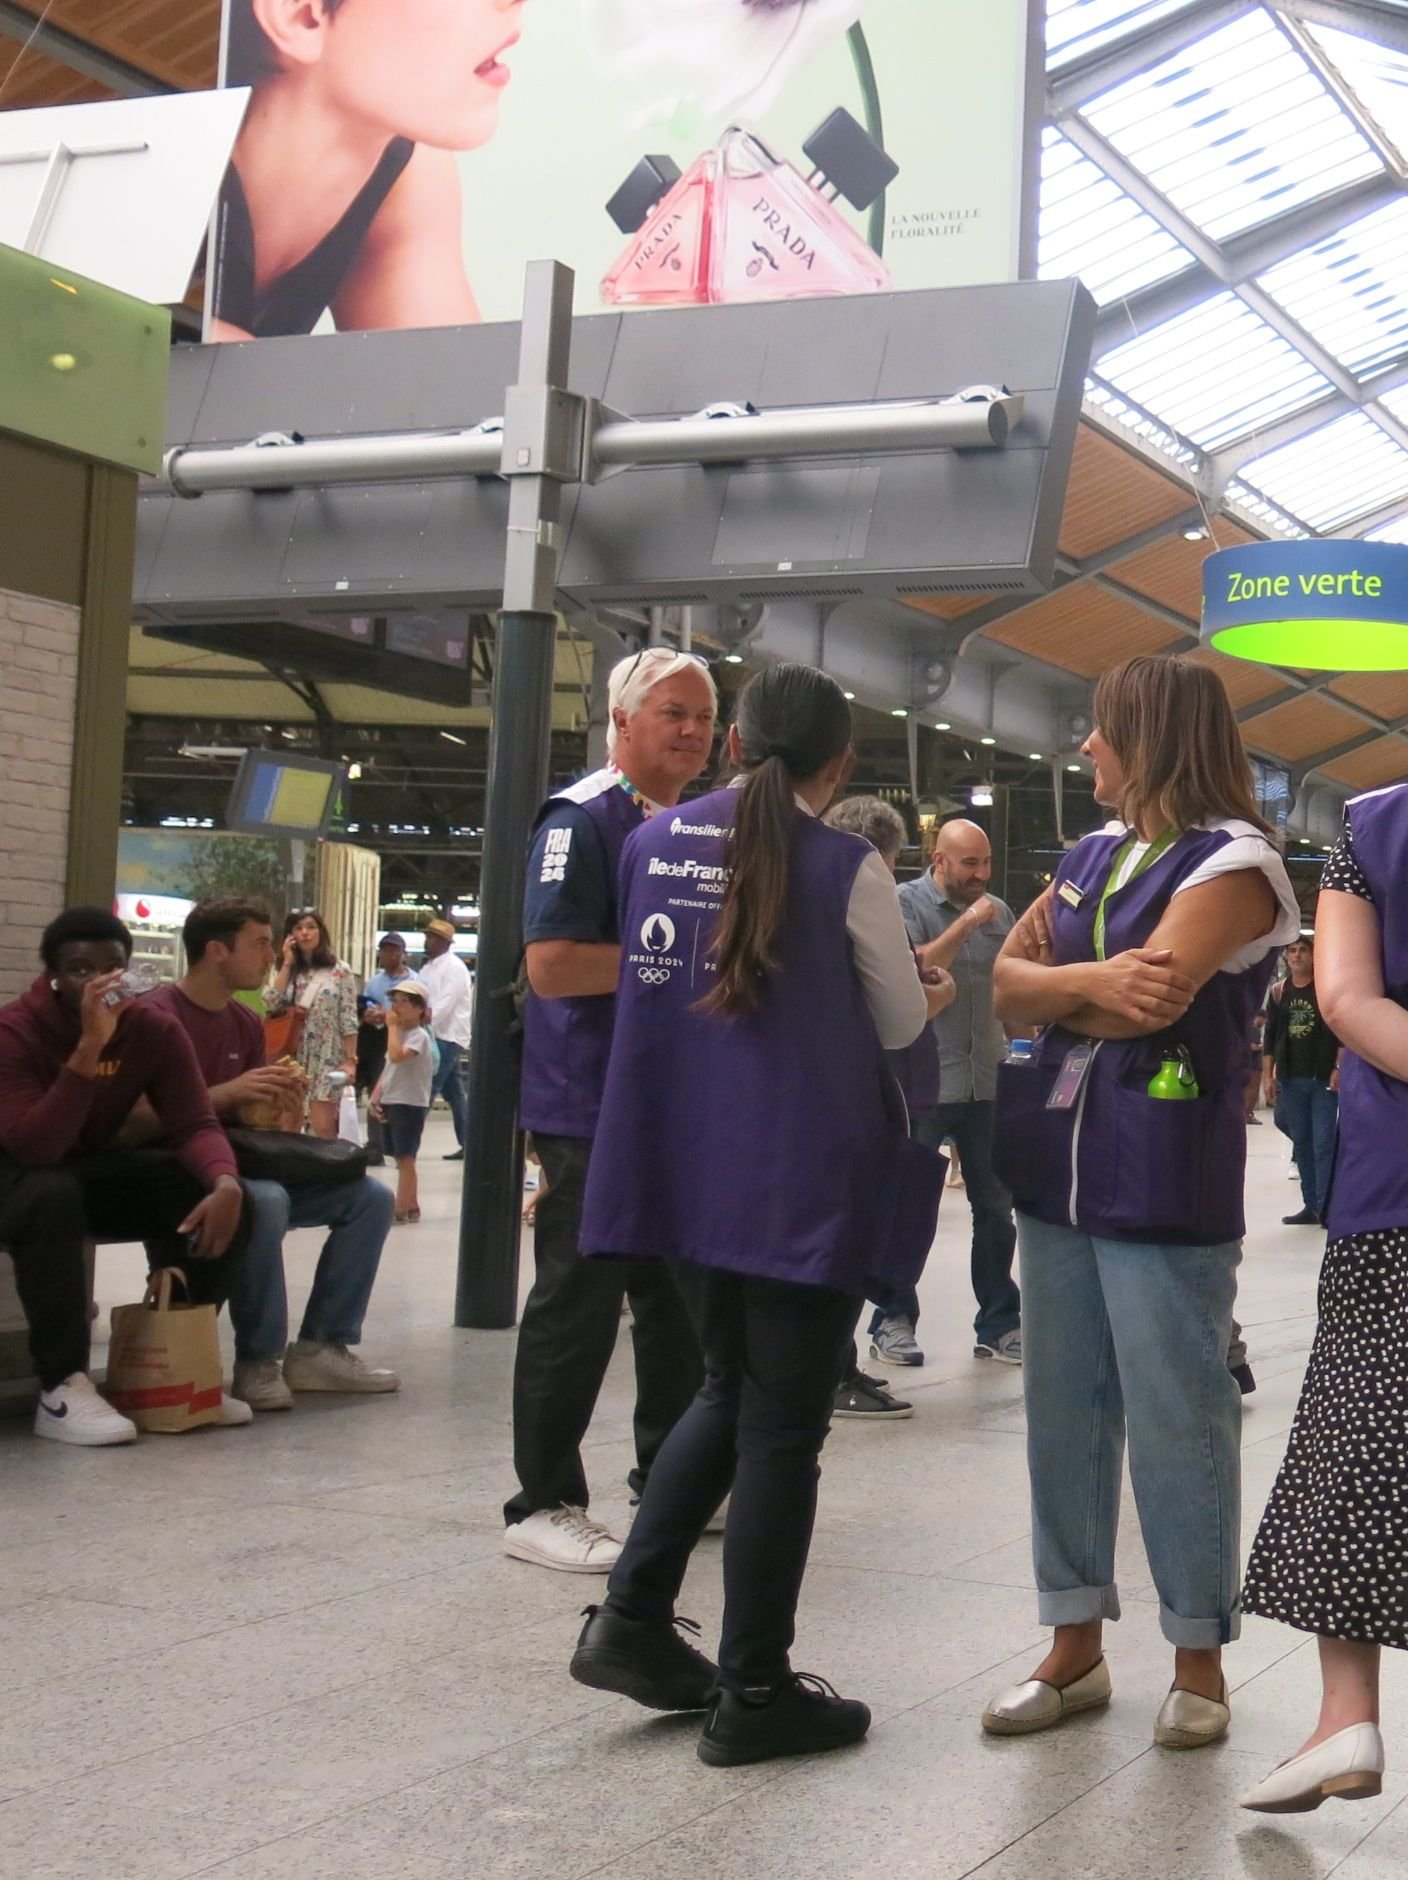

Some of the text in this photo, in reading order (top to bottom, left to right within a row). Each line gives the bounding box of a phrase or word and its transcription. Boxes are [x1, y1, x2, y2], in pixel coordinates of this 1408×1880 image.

[891, 207, 982, 225] LA NOUVELLE
[753, 197, 817, 271] PRADA
[890, 221, 964, 240] FLORALITÉ
[633, 212, 683, 271] PRADA
[1227, 570, 1383, 602] Zone verte
[544, 827, 573, 854] FRA
[542, 853, 569, 868] 20
[540, 866, 566, 882] 24
[667, 897, 707, 909] PARTENAIRE
[628, 954, 684, 968] PARIS 2024
